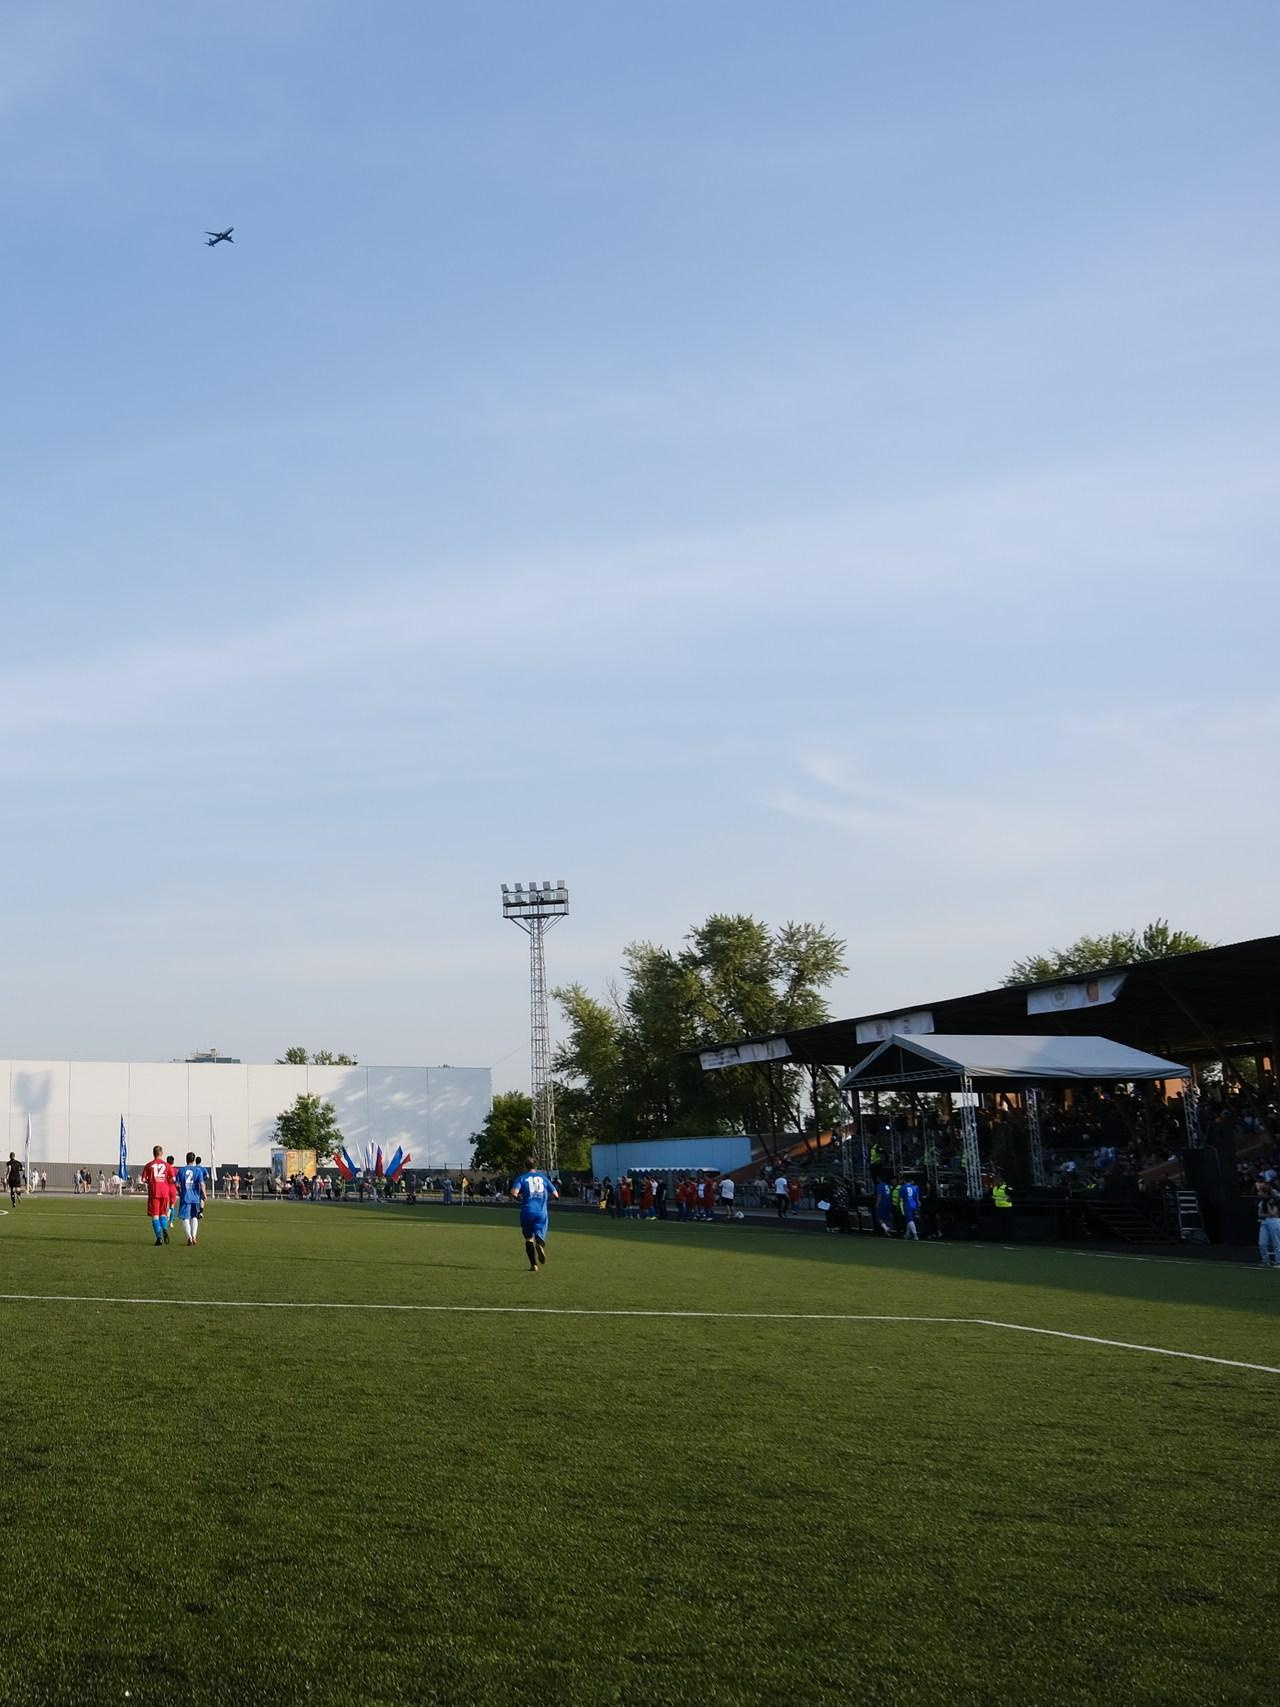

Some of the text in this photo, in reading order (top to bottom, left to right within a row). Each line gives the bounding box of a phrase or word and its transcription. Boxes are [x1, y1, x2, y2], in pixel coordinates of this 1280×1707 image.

[151, 1163, 166, 1177] 12
[185, 1169, 194, 1184] 2
[525, 1176, 544, 1192] 18
